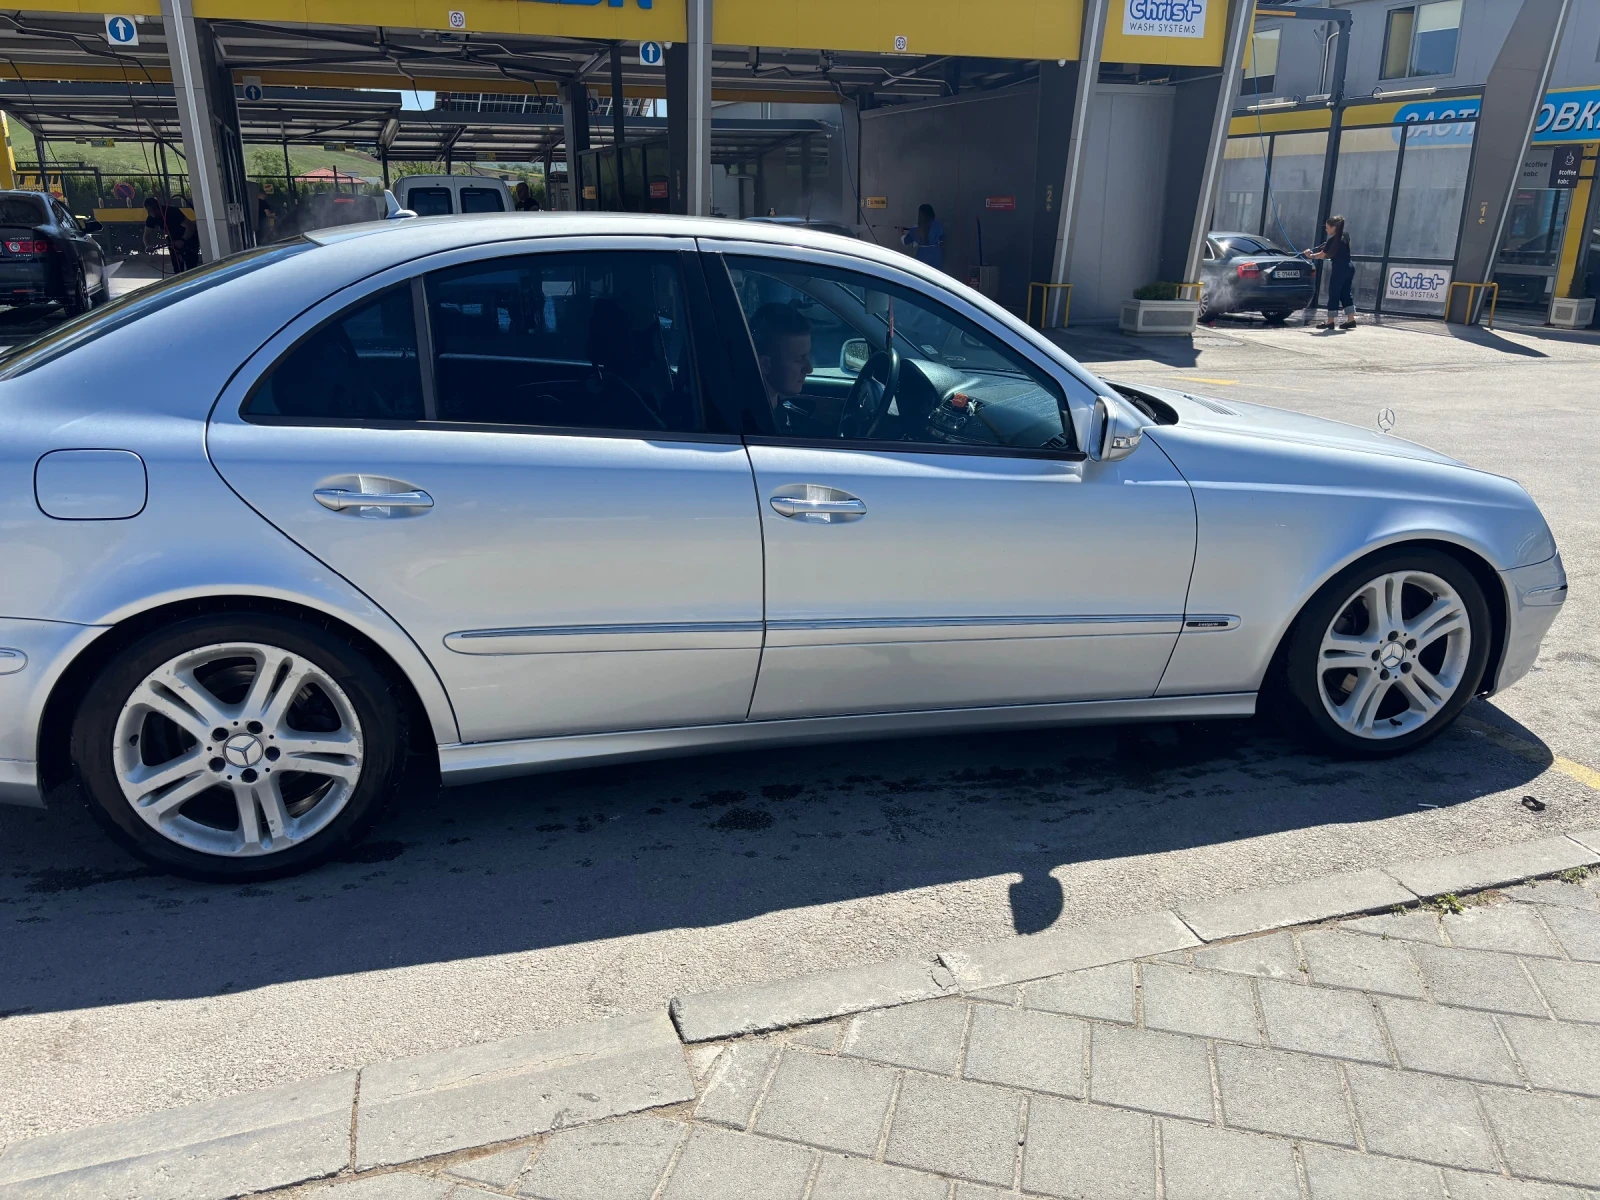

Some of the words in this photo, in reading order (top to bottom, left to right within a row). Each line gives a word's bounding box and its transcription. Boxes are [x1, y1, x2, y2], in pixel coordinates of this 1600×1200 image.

[1130, 0, 1203, 22] Christ
[1129, 22, 1154, 32] WASH
[1158, 23, 1196, 34] SYSTEMS
[1390, 271, 1445, 291] Christ
[1410, 291, 1439, 299] SYSTEMS
